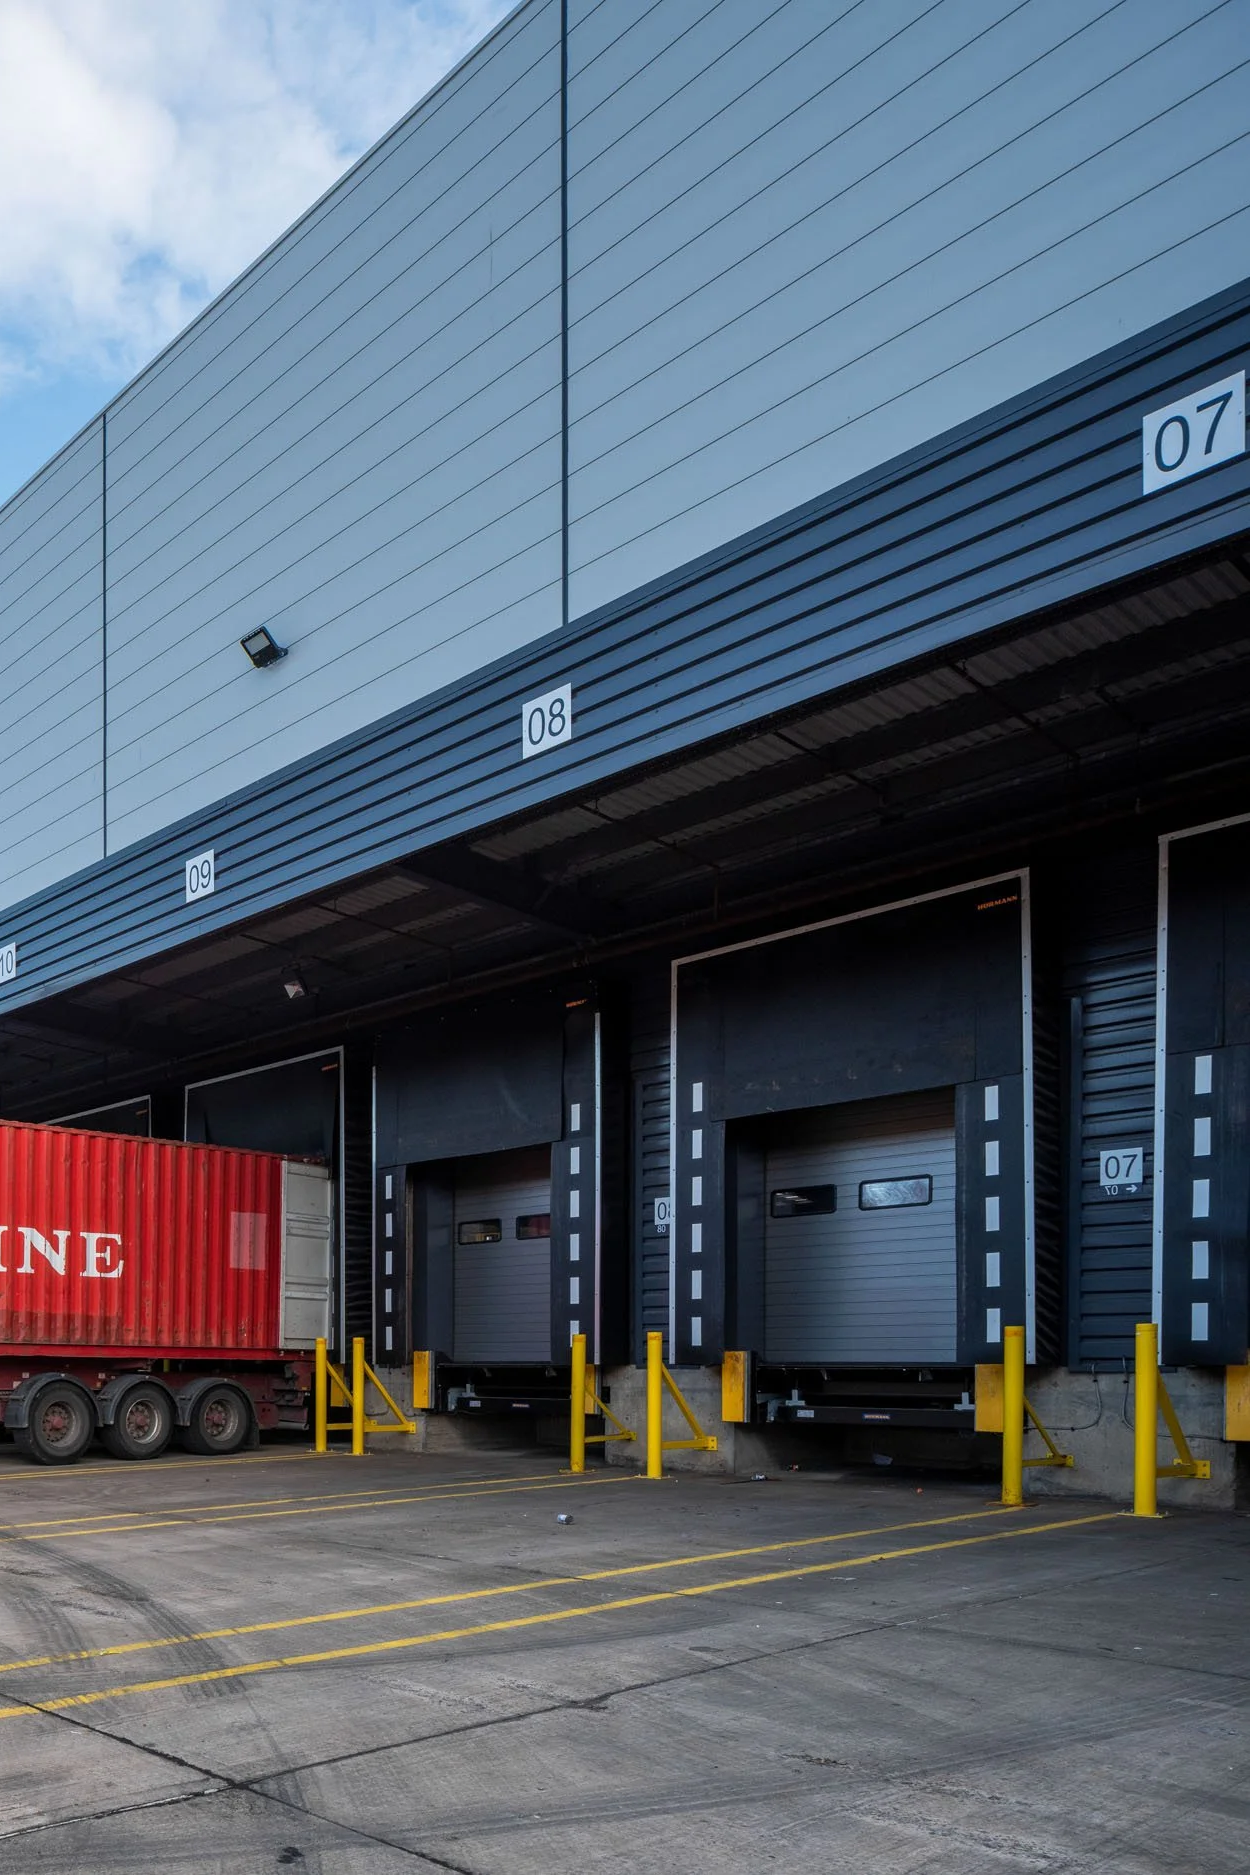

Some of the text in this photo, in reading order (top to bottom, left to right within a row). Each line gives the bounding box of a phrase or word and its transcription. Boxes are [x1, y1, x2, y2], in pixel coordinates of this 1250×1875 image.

[1155, 390, 1233, 473] 07
[528, 697, 566, 745] 08
[189, 859, 211, 893] 09
[0, 950, 14, 977] 10
[1104, 1153, 1138, 1179] 07
[657, 1201, 670, 1221] 0
